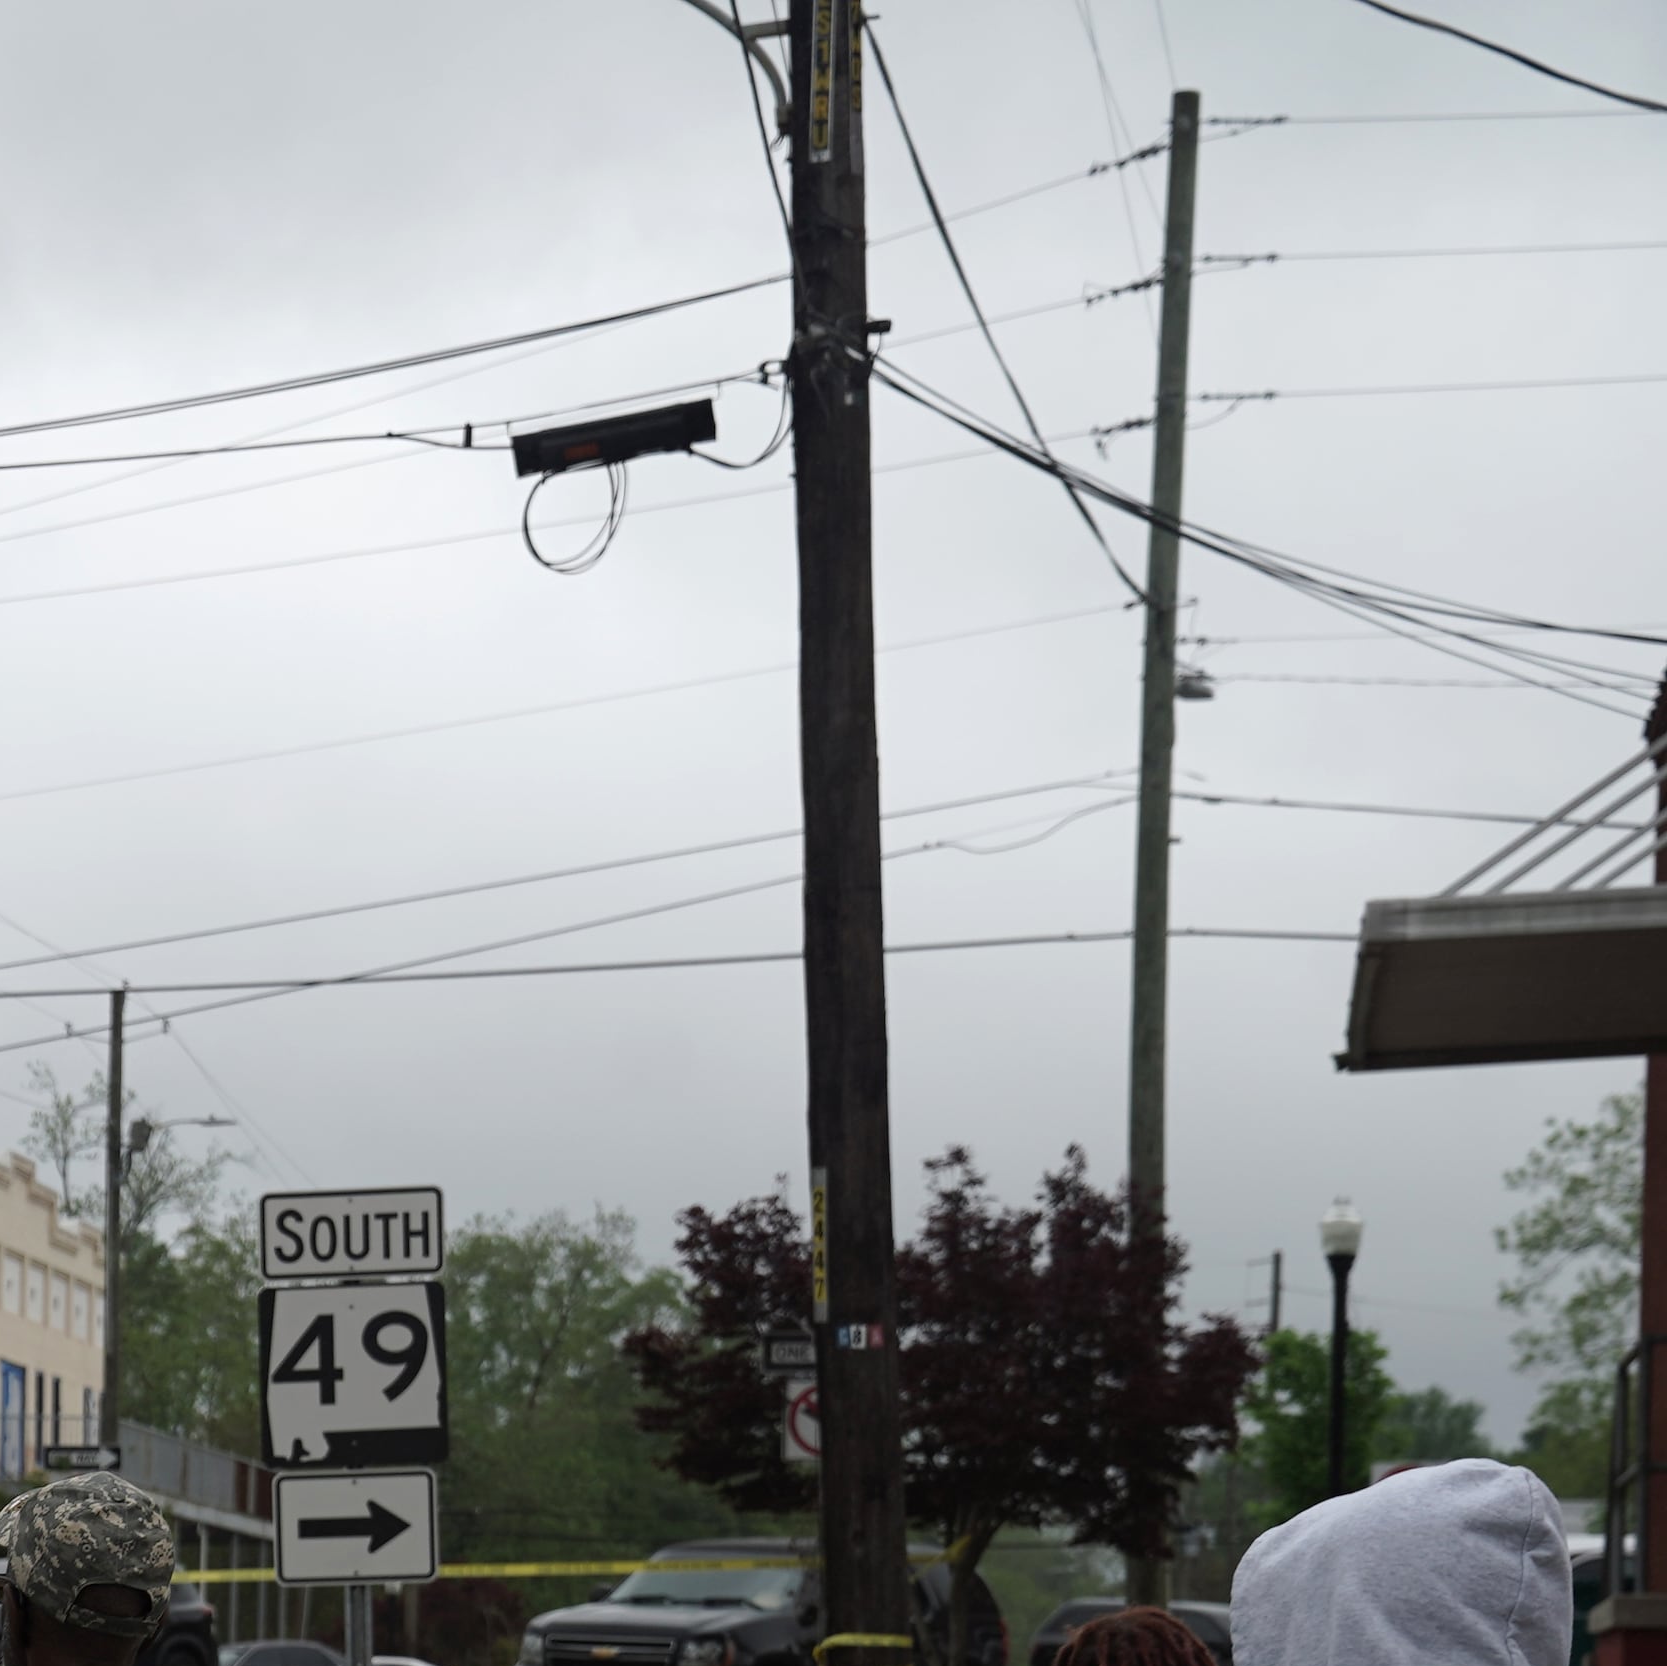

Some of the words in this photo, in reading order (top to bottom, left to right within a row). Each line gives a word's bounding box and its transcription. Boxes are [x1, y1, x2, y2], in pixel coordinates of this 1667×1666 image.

[274, 1210, 430, 1264] SOUTH
[814, 1189, 826, 1298] 2447
[271, 1311, 428, 1406] 49
